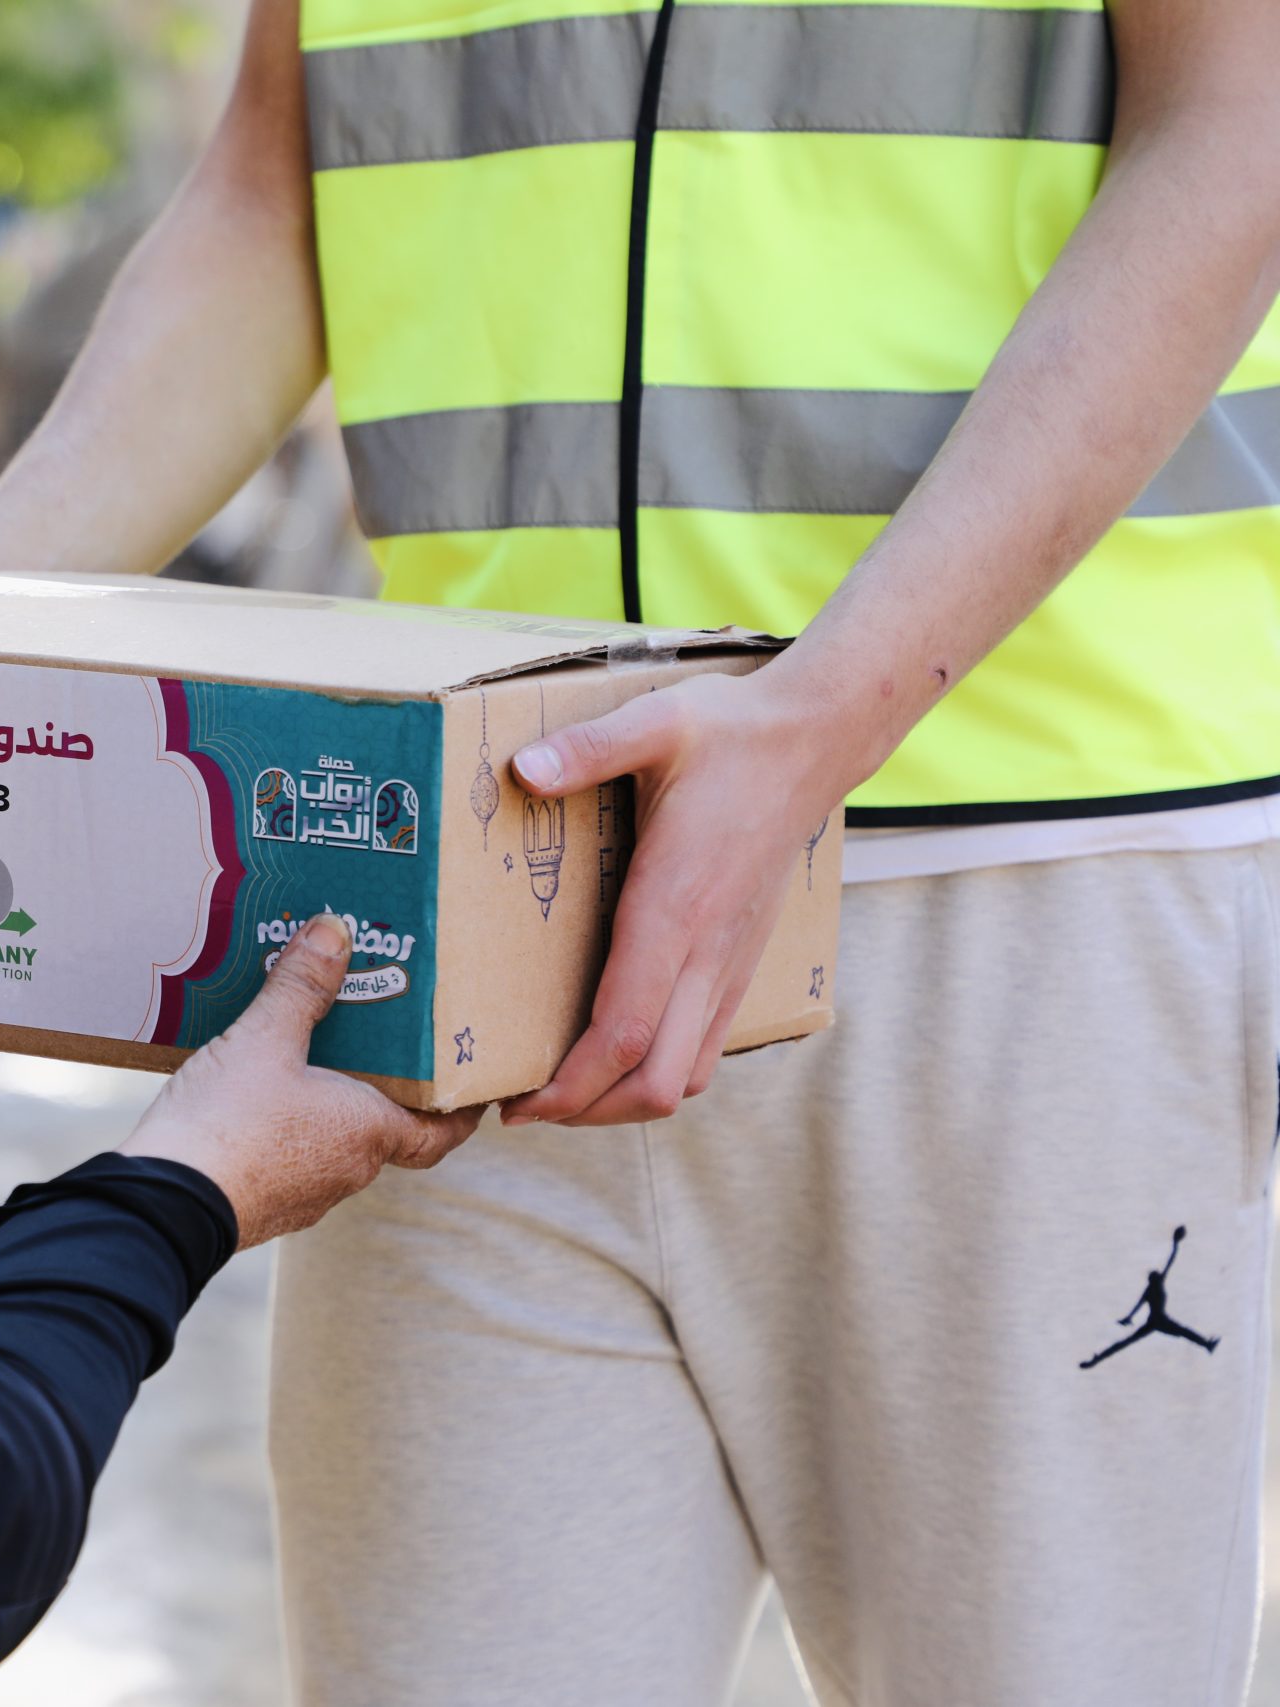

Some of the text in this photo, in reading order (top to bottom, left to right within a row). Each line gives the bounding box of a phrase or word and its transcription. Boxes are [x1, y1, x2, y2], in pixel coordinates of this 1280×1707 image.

[318, 754, 355, 771] حملة
[300, 772, 372, 812] أبواب
[299, 812, 370, 845] الخير
[338, 912, 416, 962] رمضا
